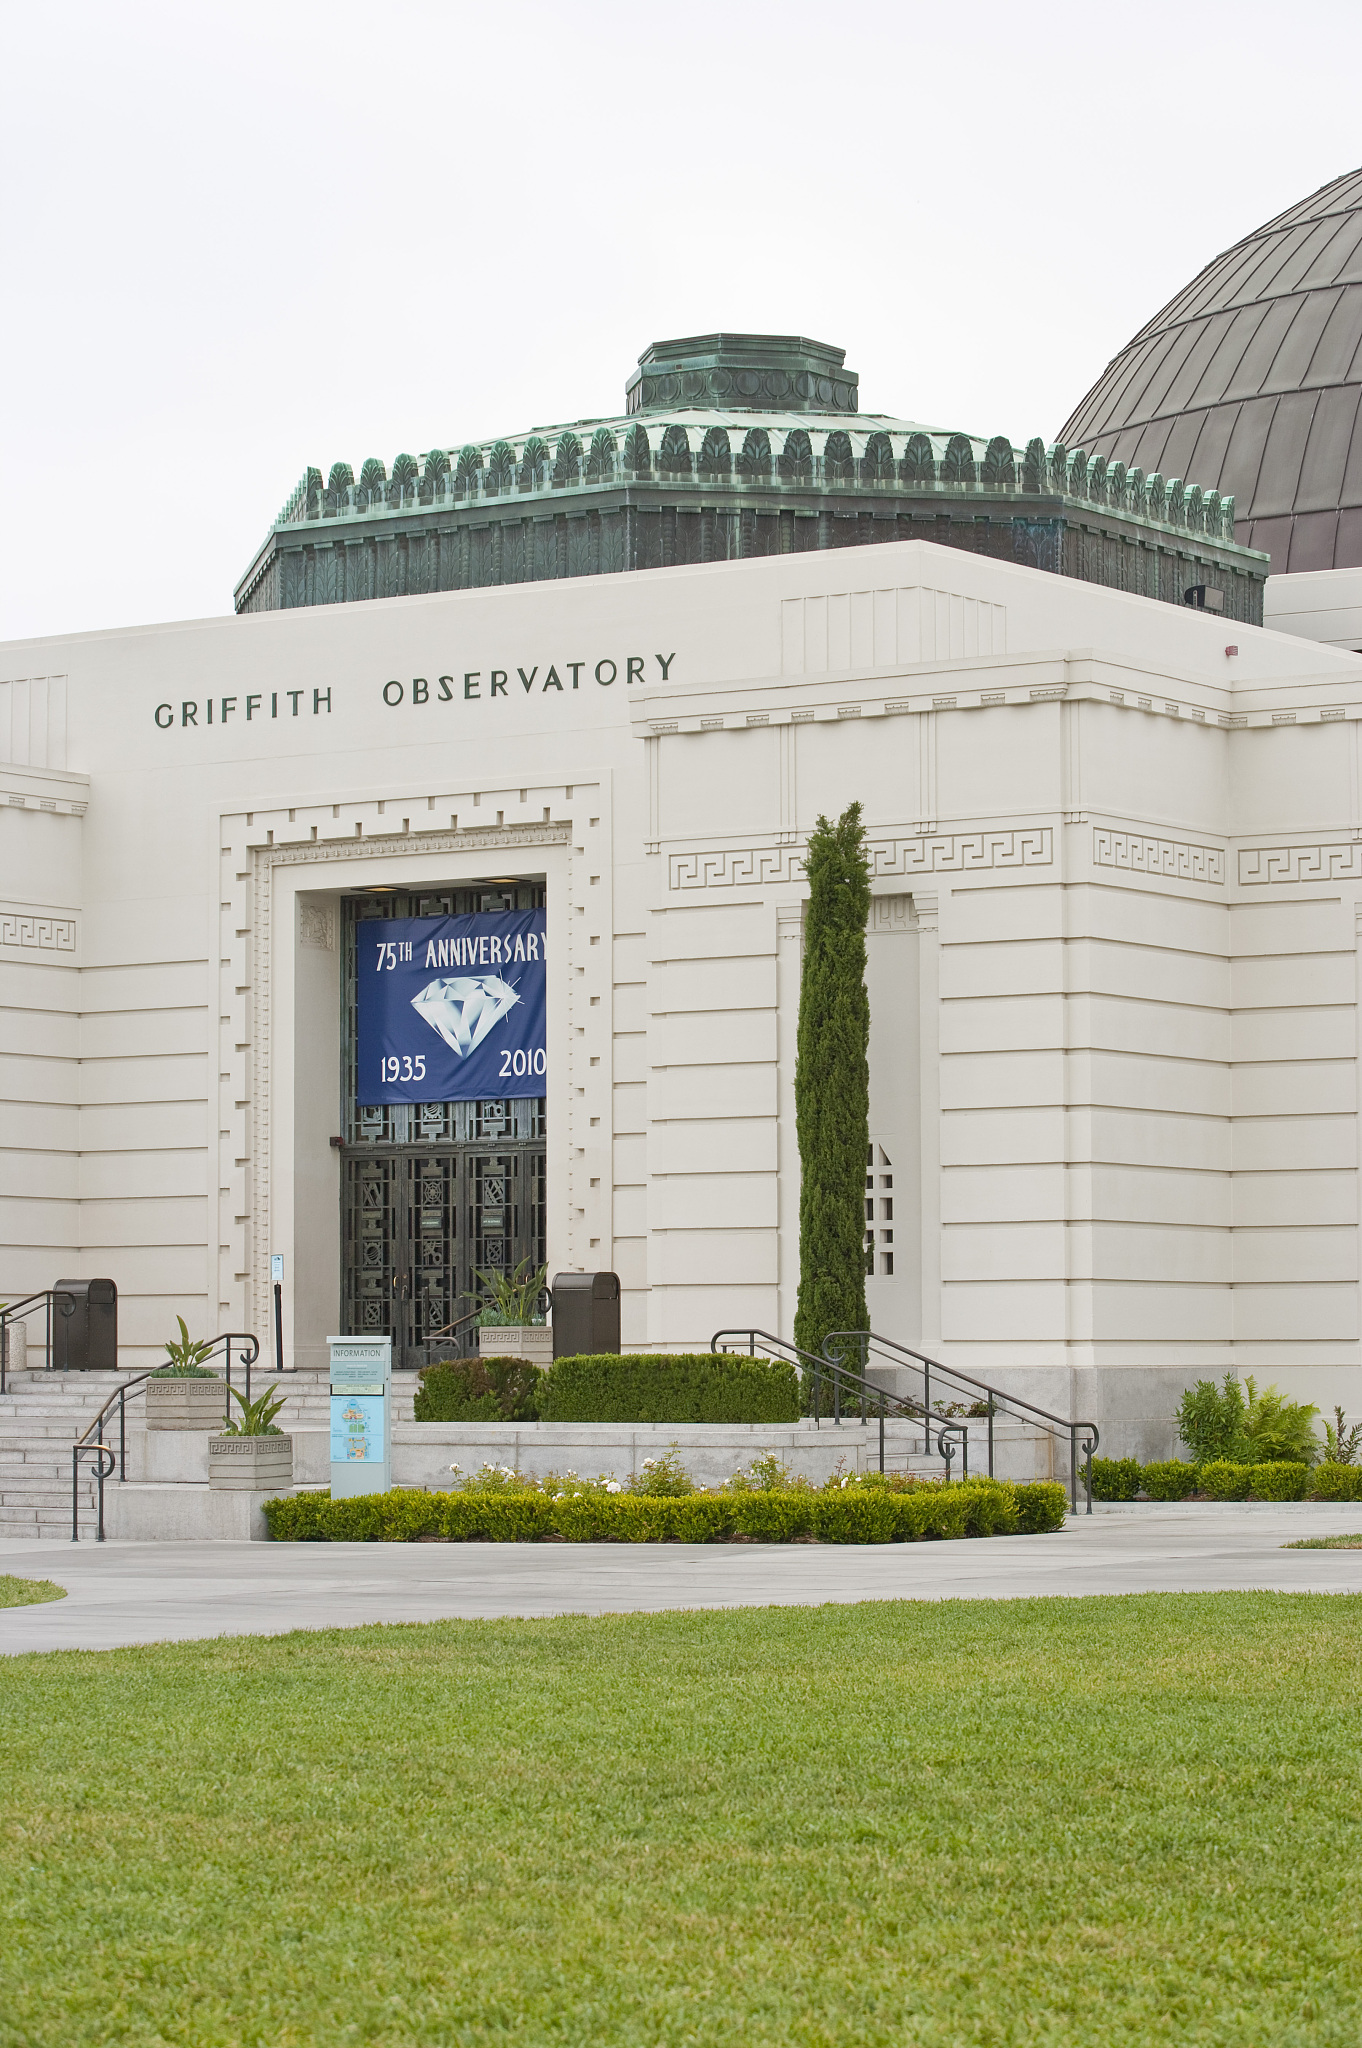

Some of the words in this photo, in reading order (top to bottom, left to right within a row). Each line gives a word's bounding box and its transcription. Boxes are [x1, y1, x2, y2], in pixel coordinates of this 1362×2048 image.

[154, 686, 333, 729] GRIFFITH
[383, 652, 676, 707] OBSERVATORY
[376, 941, 413, 971] 75TH
[425, 932, 547, 968] ANNIVERSARY
[381, 1055, 426, 1083] 1935
[499, 1048, 547, 1077] 2010
[333, 1349, 381, 1357] INFORMATION
